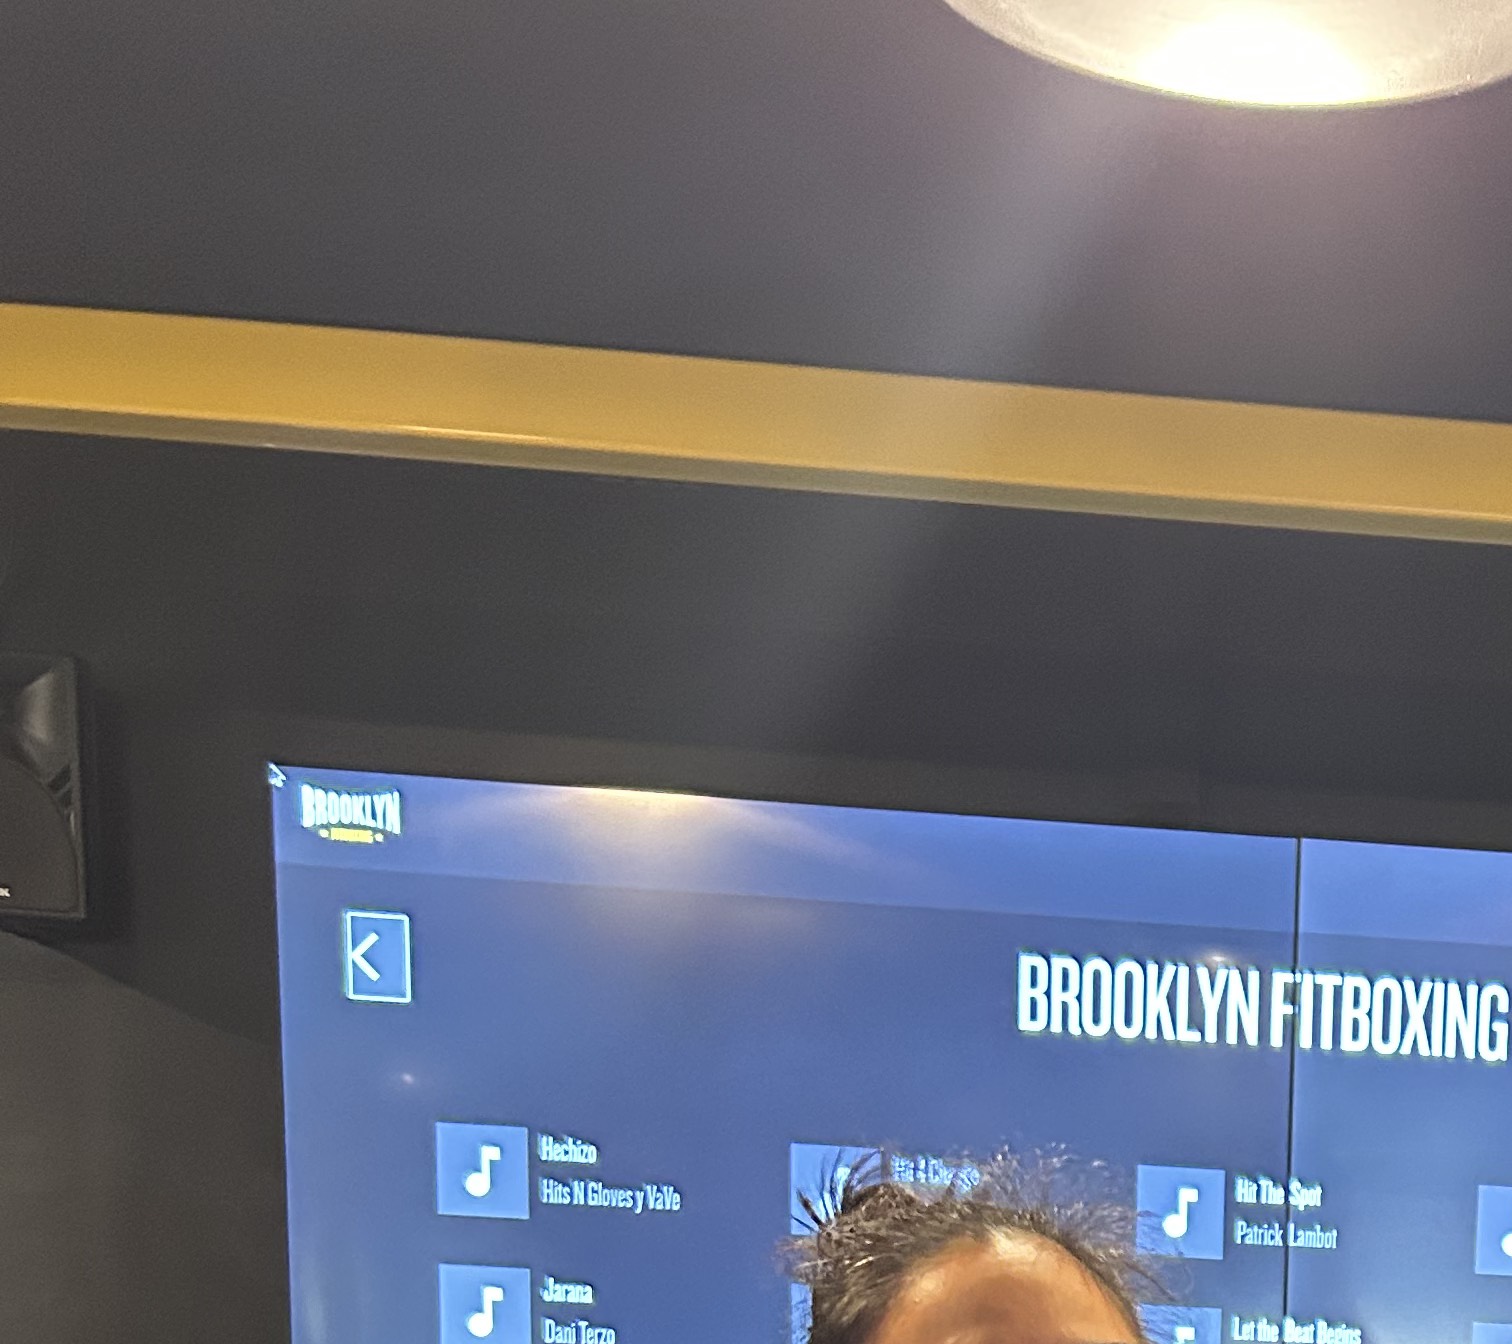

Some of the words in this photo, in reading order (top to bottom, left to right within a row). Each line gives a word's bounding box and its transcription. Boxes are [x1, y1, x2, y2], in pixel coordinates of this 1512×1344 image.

[301, 783, 401, 835] BROOKLYN
[1016, 951, 1259, 1046] BROOKLYN
[1271, 968, 1509, 1062] FITBOXING
[539, 1133, 598, 1164] Hechizo
[541, 1177, 571, 1205] Hits
[572, 1179, 585, 1206] N
[587, 1180, 634, 1208] Gloves
[634, 1189, 645, 1215] y
[645, 1183, 682, 1212] VaVe
[1236, 1176, 1258, 1204] Hit
[1258, 1178, 1285, 1205] The
[1289, 1178, 1322, 1211] Spot
[1236, 1219, 1284, 1247] Patrick
[1287, 1222, 1338, 1249] Lambot
[540, 1276, 594, 1303] Jarana
[542, 1317, 576, 1344] Dani
[1232, 1315, 1256, 1342] Let
[1256, 1316, 1279, 1343] the
[1283, 1315, 1315, 1344] Beat
